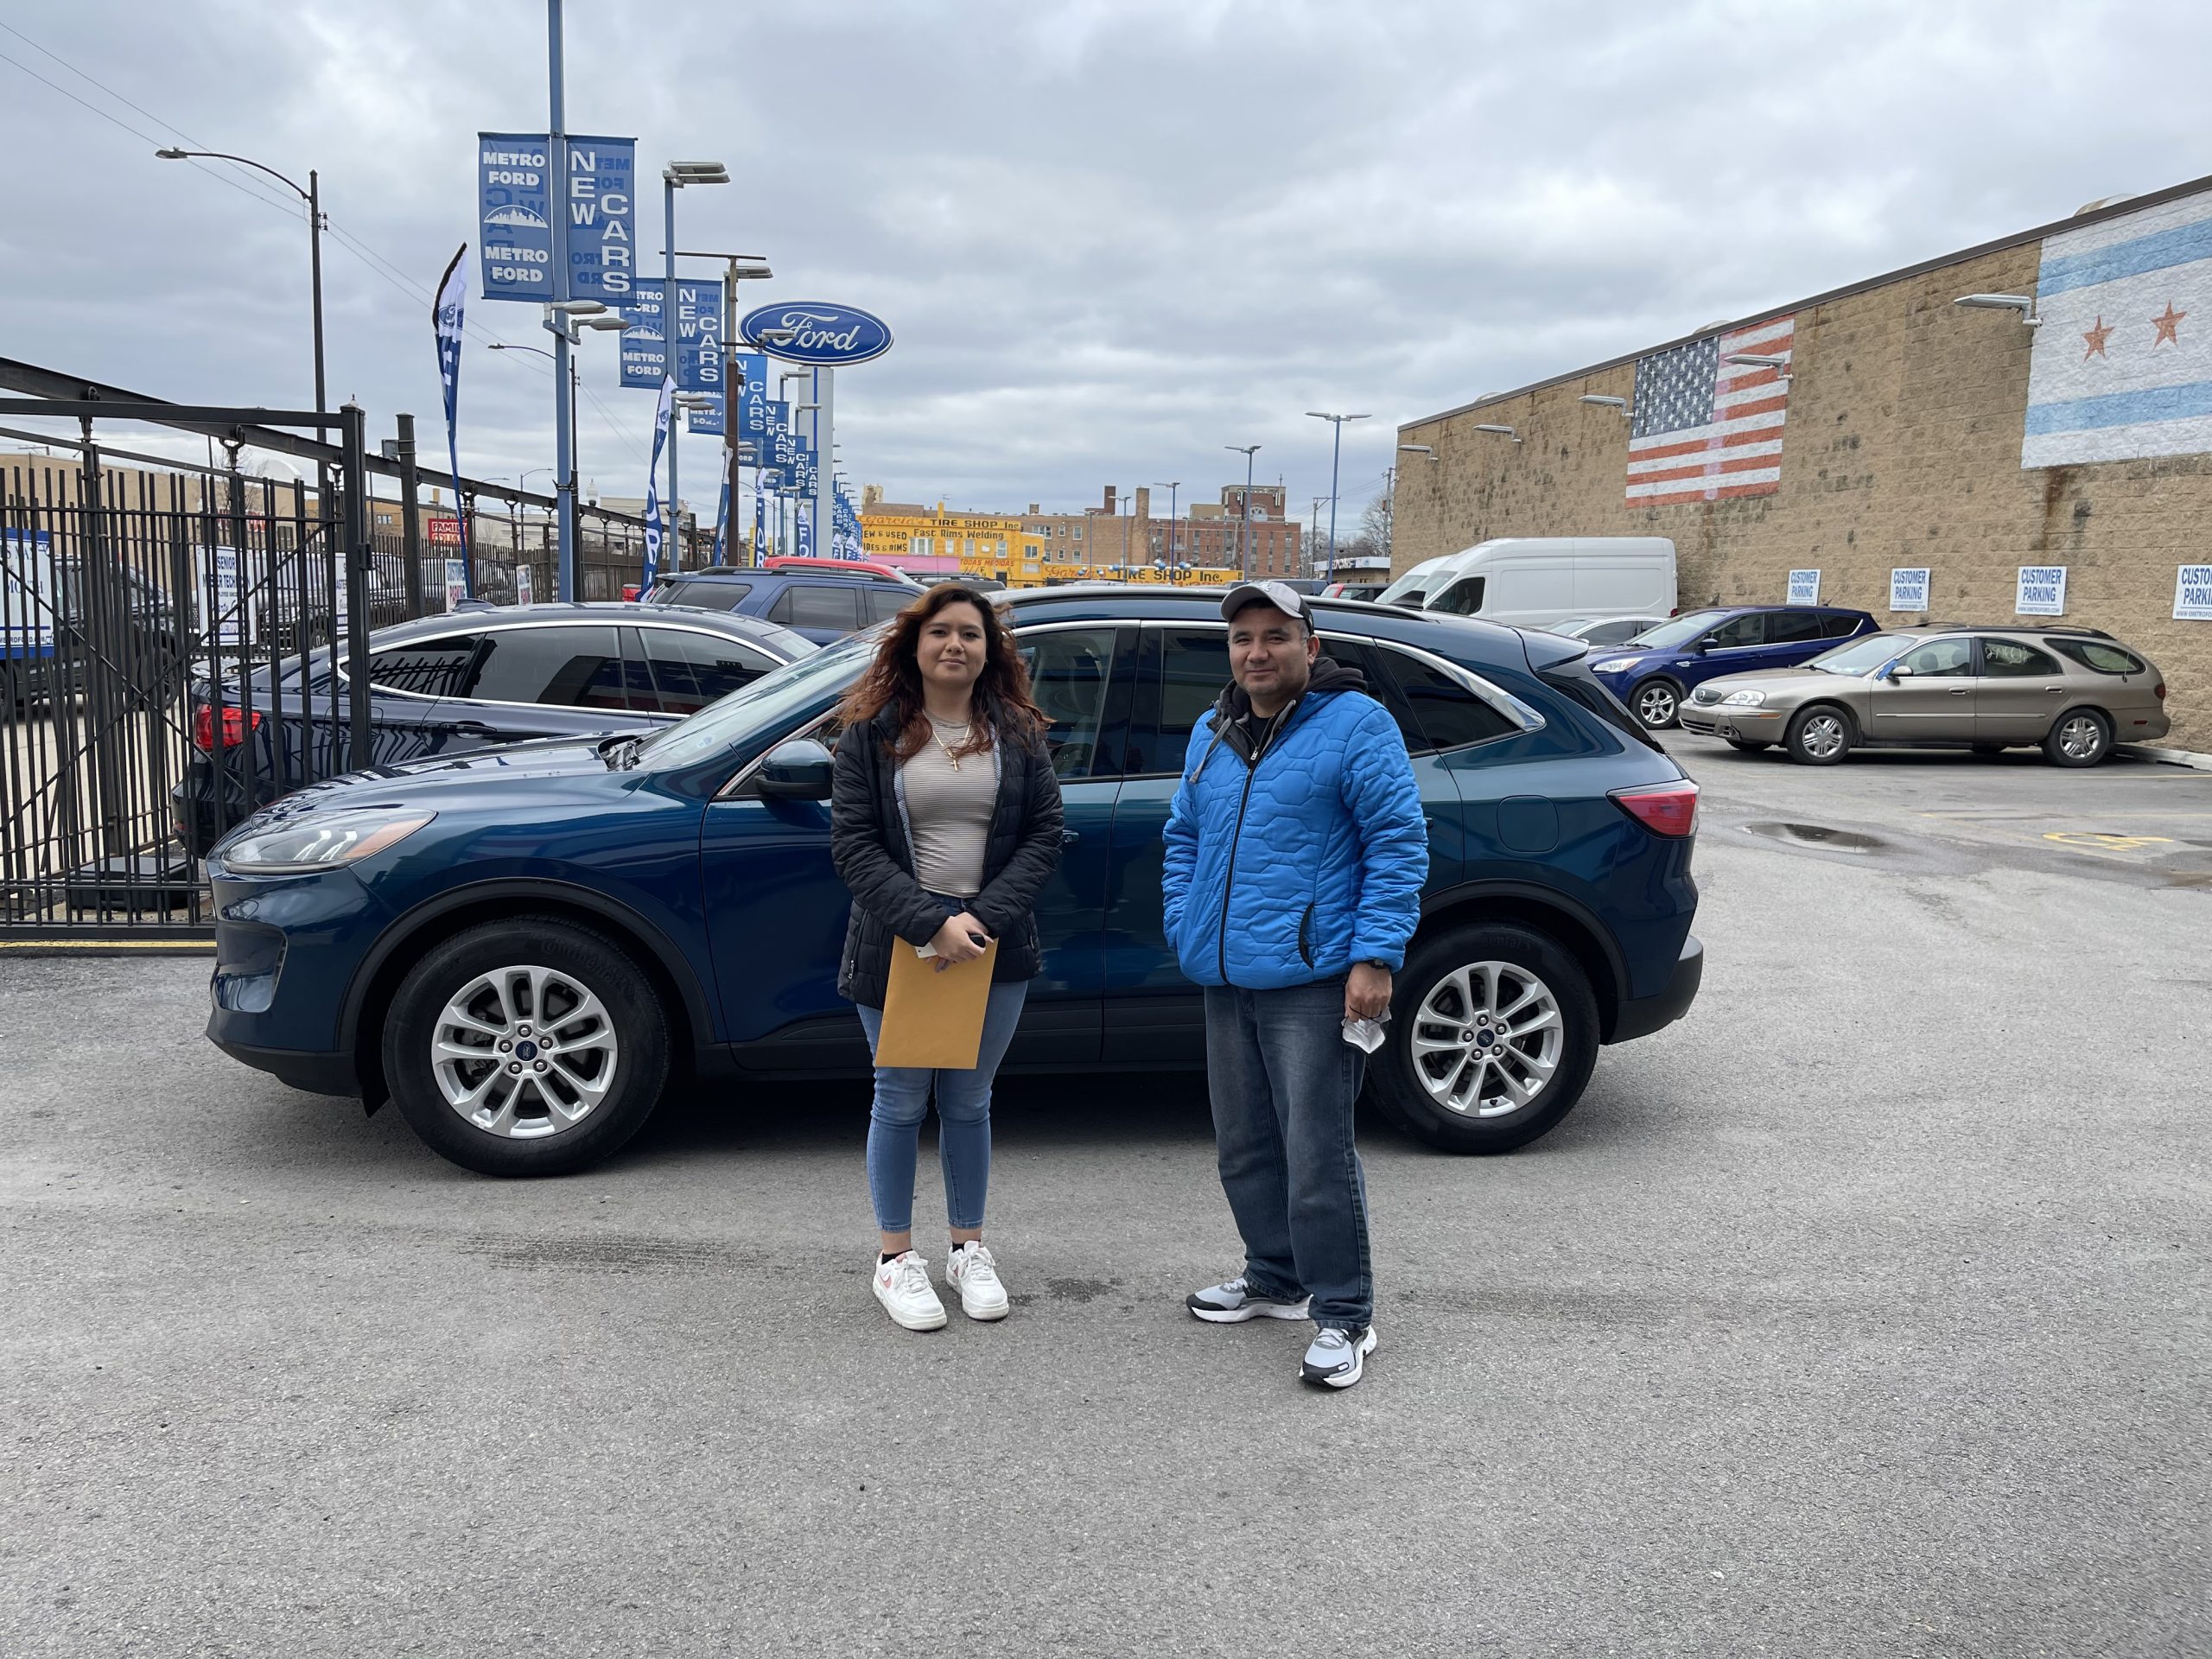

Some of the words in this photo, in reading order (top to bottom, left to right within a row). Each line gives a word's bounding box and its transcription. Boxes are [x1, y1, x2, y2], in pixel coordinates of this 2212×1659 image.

[483, 151, 546, 168] METRO
[488, 171, 540, 187] FORD
[571, 150, 596, 226] NEW
[601, 194, 631, 292] CARS
[485, 246, 549, 264] METRO
[492, 266, 543, 283] FORD
[637, 290, 664, 302] ETRO
[679, 289, 696, 338] NEW
[772, 311, 861, 352] Ford
[699, 316, 719, 382] CARS
[622, 352, 665, 363] METRO
[627, 365, 662, 376] FORD
[749, 381, 764, 430] CARS
[775, 423, 787, 463] CARS
[796, 454, 806, 486] CARS
[809, 467, 817, 496] CARS
[886, 531, 907, 540] USED
[967, 531, 1004, 540] Welding
[218, 556, 236, 569] SENIOR
[1154, 570, 1192, 581] SHOP
[1199, 571, 1224, 582] Inc.
[1791, 571, 1817, 583] CUSTOMER
[1893, 570, 1926, 584] CUSTOMER
[2022, 569, 2062, 584] CUSTOMER
[2182, 568, 2212, 585] CUSTO
[1791, 585, 1813, 597] PARKING
[1895, 586, 1923, 600] PARKING
[2023, 586, 2056, 602] PARKING
[2183, 588, 2212, 605] PARKI
